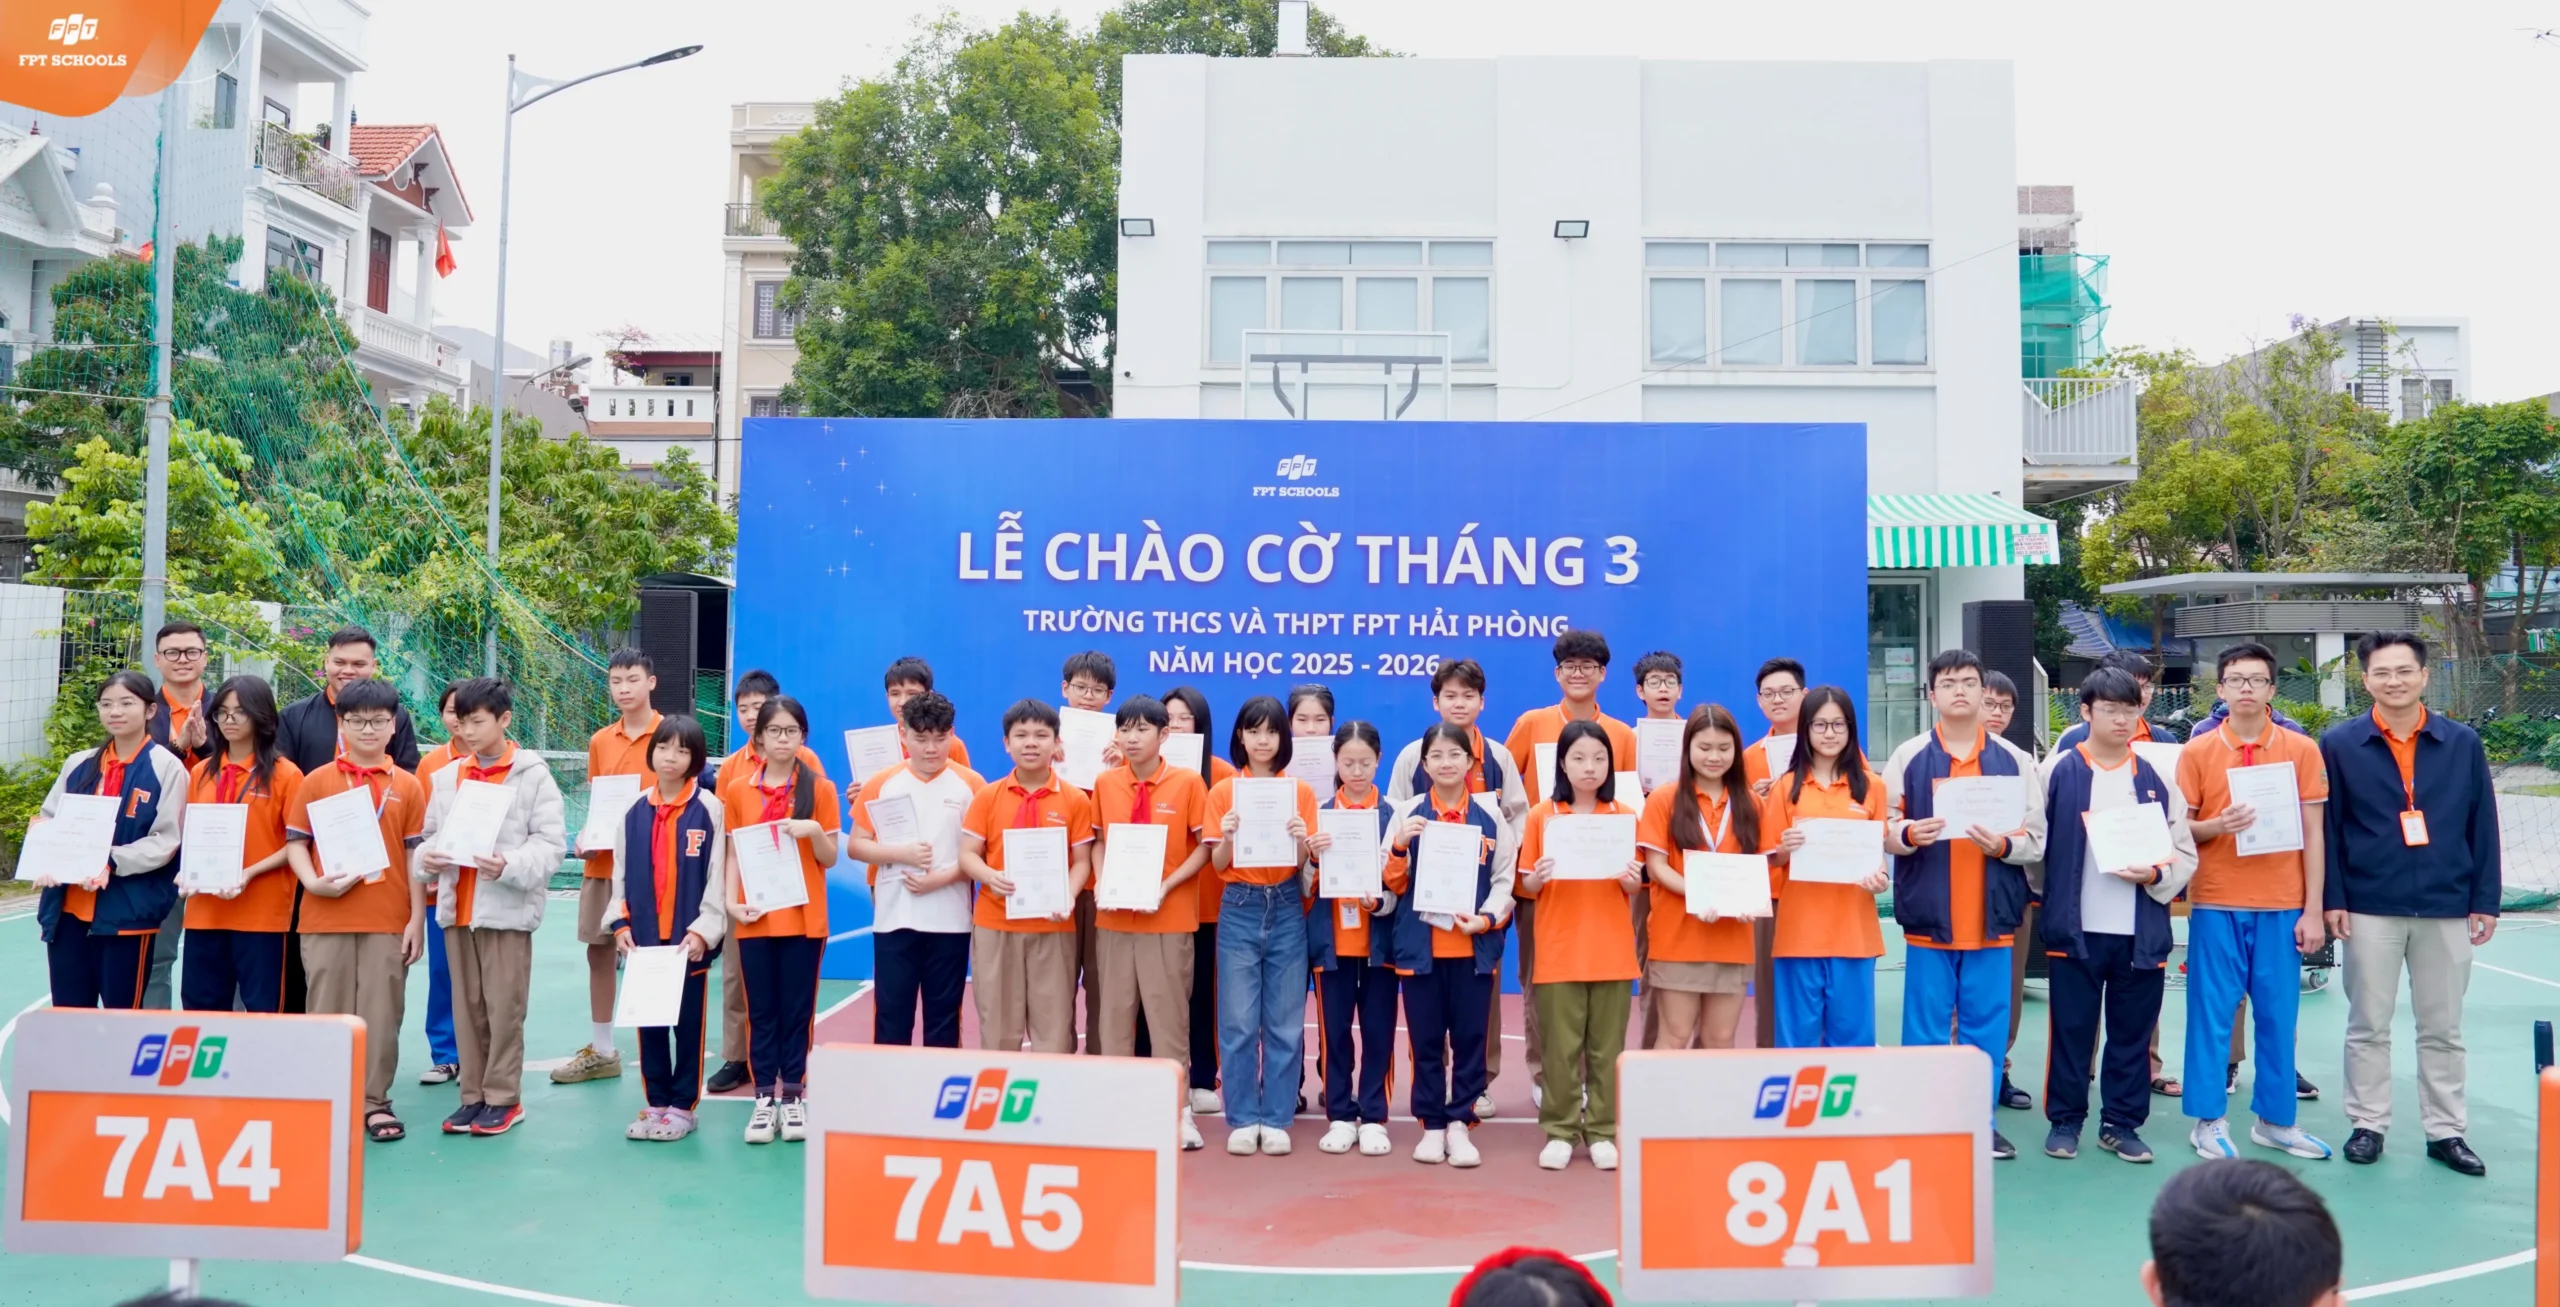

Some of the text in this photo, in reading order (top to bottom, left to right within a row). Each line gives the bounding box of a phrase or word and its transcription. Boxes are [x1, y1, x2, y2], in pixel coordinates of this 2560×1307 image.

[1252, 486, 1340, 498] FPT SCHOOLS
[959, 511, 1640, 586] LỄ CHÀO CỜ THÁNG 3
[1023, 605, 1569, 638] TRƯỜNG THCS VÀ THPT FPT HẢI PHÒNG
[1149, 645, 1214, 673] NĂM
[1223, 651, 1283, 680] HỌC
[1290, 652, 1354, 676] 2025
[1377, 653, 1441, 676] 2026
[685, 829, 706, 857] F
[130, 1026, 228, 1087] FPT
[934, 1068, 1039, 1131] FPT
[1753, 1065, 1857, 1128] FPT
[95, 1115, 281, 1203] 7A4
[884, 1155, 1083, 1253] 7A5
[1726, 1159, 1912, 1247] 8A1
